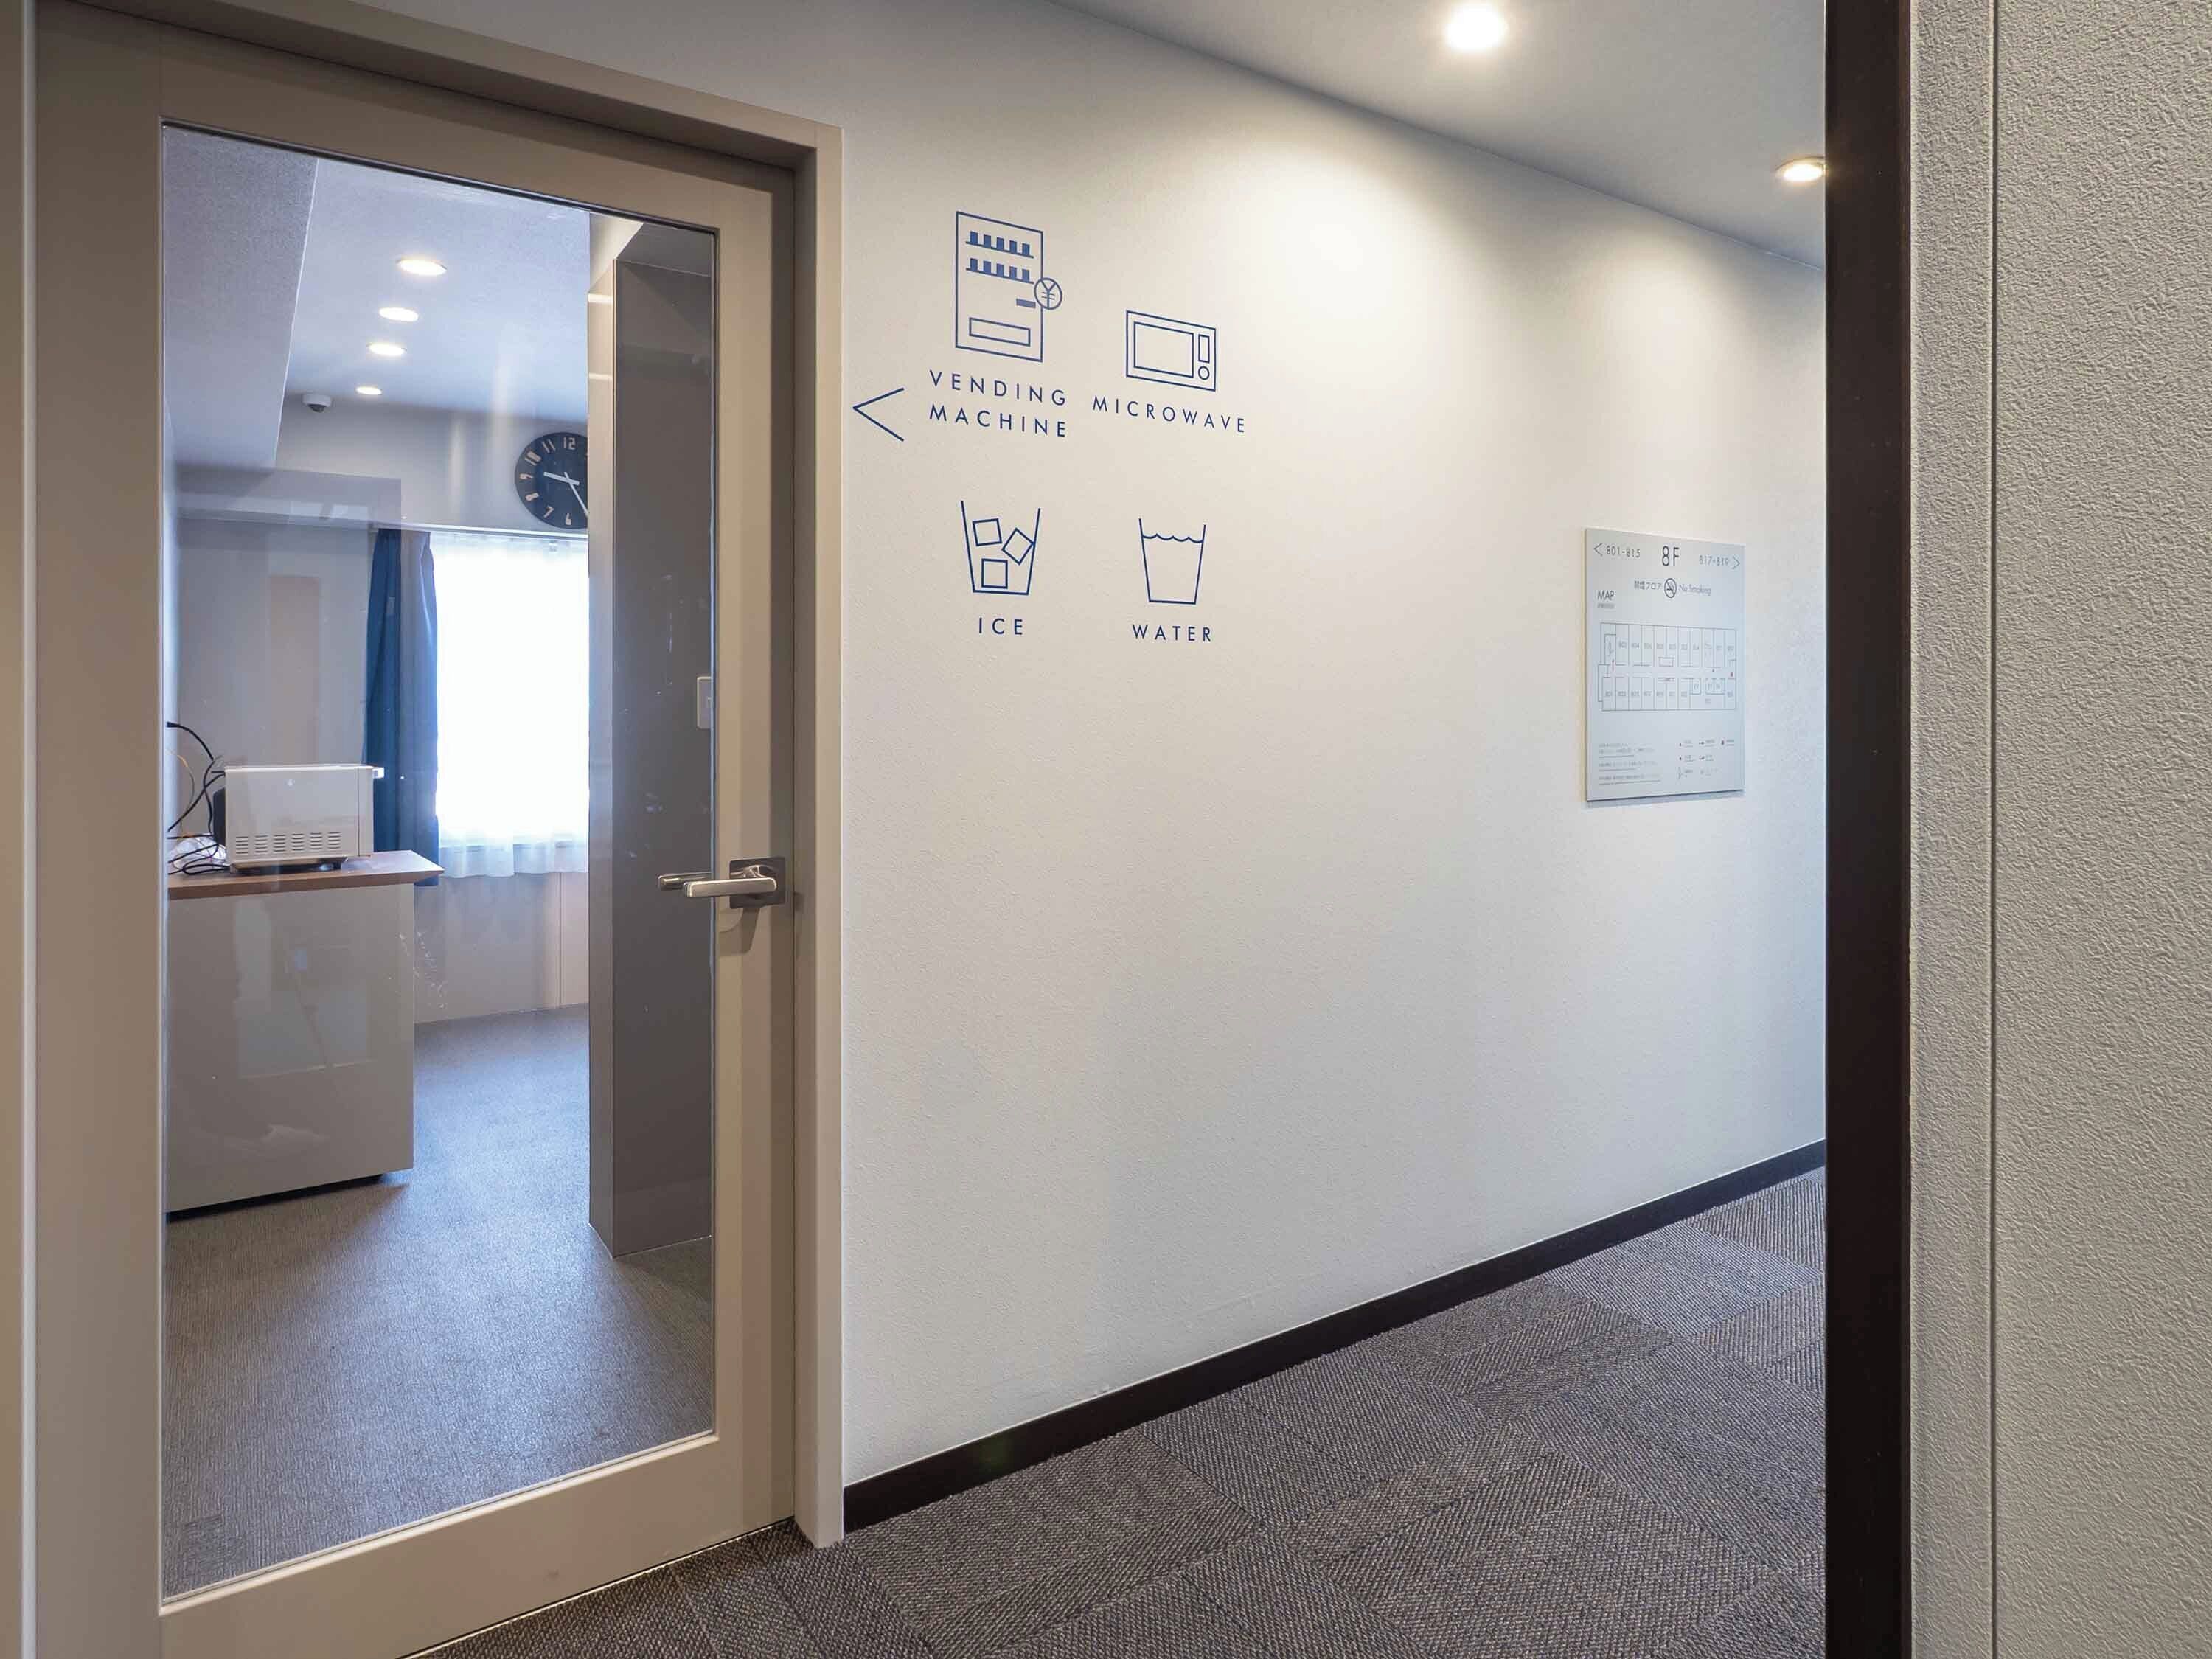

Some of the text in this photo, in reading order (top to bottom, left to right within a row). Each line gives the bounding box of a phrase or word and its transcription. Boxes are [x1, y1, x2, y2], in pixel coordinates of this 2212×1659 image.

[929, 370, 1065, 406] VENDING
[929, 404, 1065, 437] MACHINE
[1093, 394, 1245, 433] MICROWAVE
[542, 439, 555, 453] 11
[563, 437, 575, 450] 12
[525, 451, 542, 466] 10
[525, 493, 539, 501] 8
[543, 506, 554, 518] 7
[565, 513, 572, 525] 6
[1606, 546, 1641, 558] 801-815
[1662, 546, 1680, 567] 8F
[1597, 590, 1615, 601] MAP
[978, 617, 1023, 636] ICE
[1132, 624, 1211, 643] WATER
